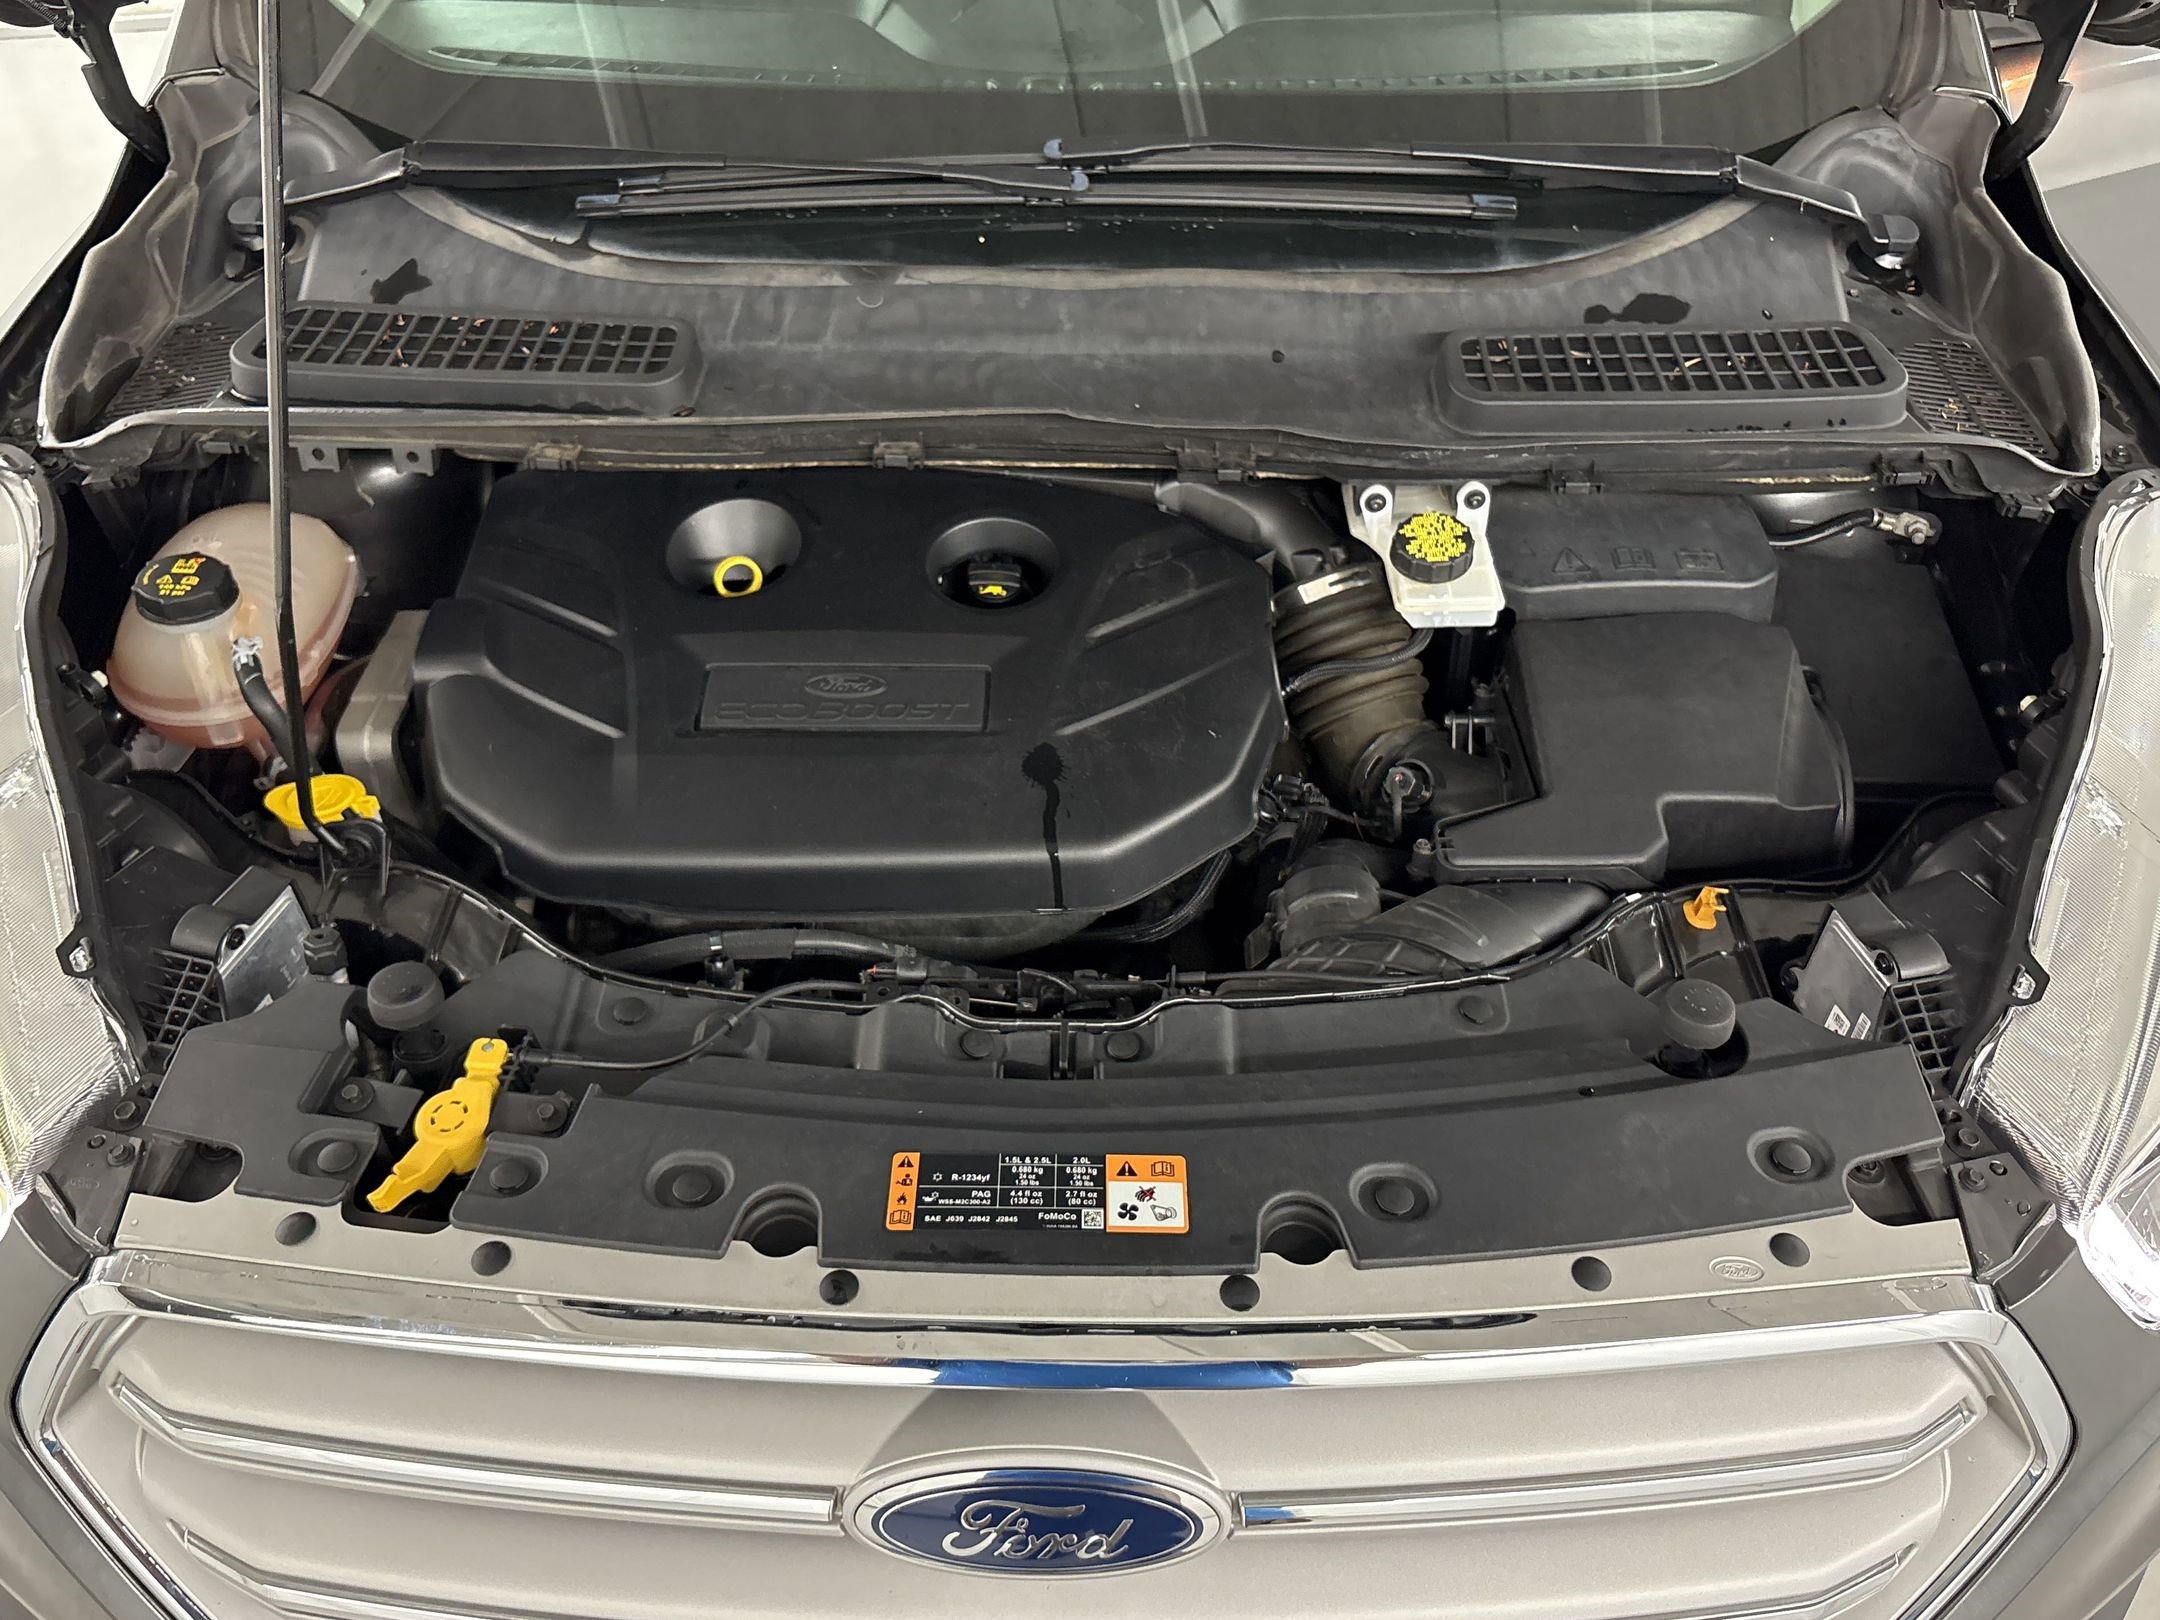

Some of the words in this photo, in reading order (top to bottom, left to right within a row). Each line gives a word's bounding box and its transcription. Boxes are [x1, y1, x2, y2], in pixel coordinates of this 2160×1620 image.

[1024, 1156, 1031, 1164] &
[1033, 1156, 1052, 1164] 2.5L
[1033, 1166, 1044, 1175] kg
[1087, 1167, 1098, 1175] kg
[951, 1173, 991, 1182] R-1234yf
[971, 1190, 992, 1198] PAG
[1065, 1190, 1078, 1198] 2.7
[1079, 1190, 1086, 1198] fl
[1010, 1197, 1029, 1205] (130
[1029, 1197, 1044, 1206] cc)
[1067, 1198, 1081, 1206] (80
[1082, 1198, 1097, 1206] cc)
[1038, 1211, 1077, 1220] FoMoCo
[941, 1499, 1134, 1560] Ford
